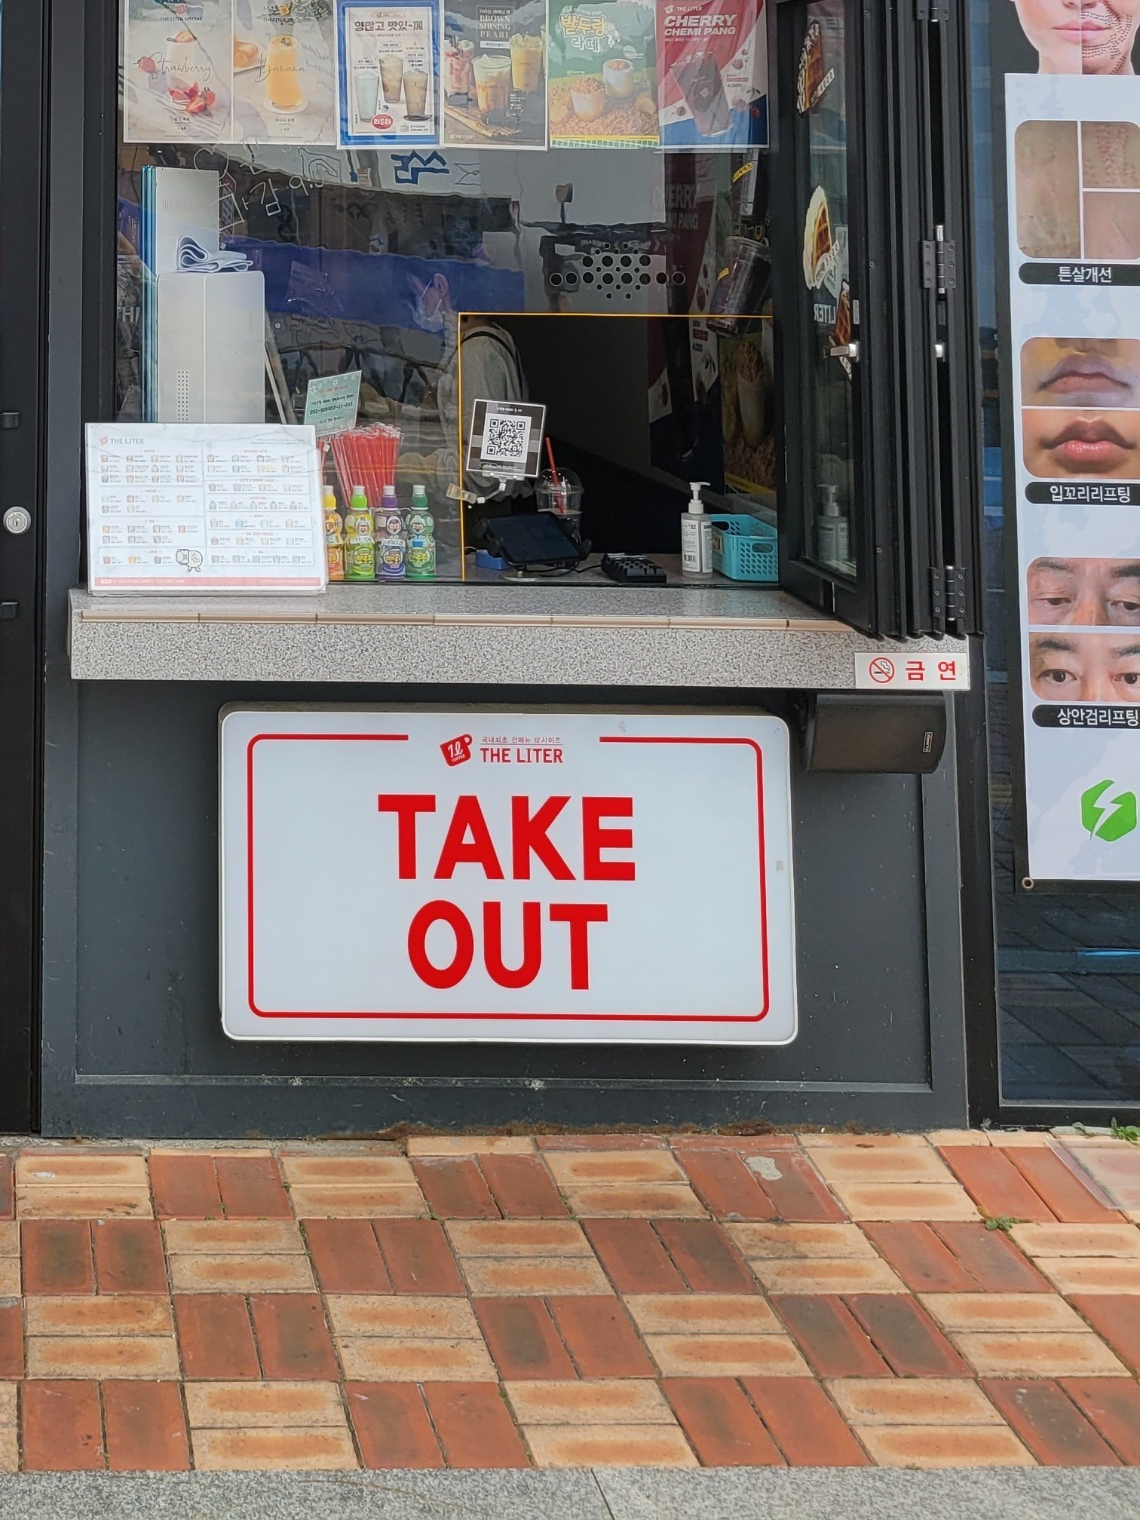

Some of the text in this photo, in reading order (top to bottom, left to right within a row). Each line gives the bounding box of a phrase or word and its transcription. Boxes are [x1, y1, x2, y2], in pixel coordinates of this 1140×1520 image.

[665, 14, 738, 27] CHERRY
[665, 27, 736, 36] CHEMI PANG
[572, 35, 600, 52] 라떼
[1058, 266, 1112, 283] 튼살개선
[1049, 485, 1131, 503] 입꼬리리프팅
[1057, 708, 1139, 726] 상안검리프팅
[480, 748, 563, 763] THE LITER
[377, 794, 636, 881] TAKE
[407, 900, 608, 991] OUT
